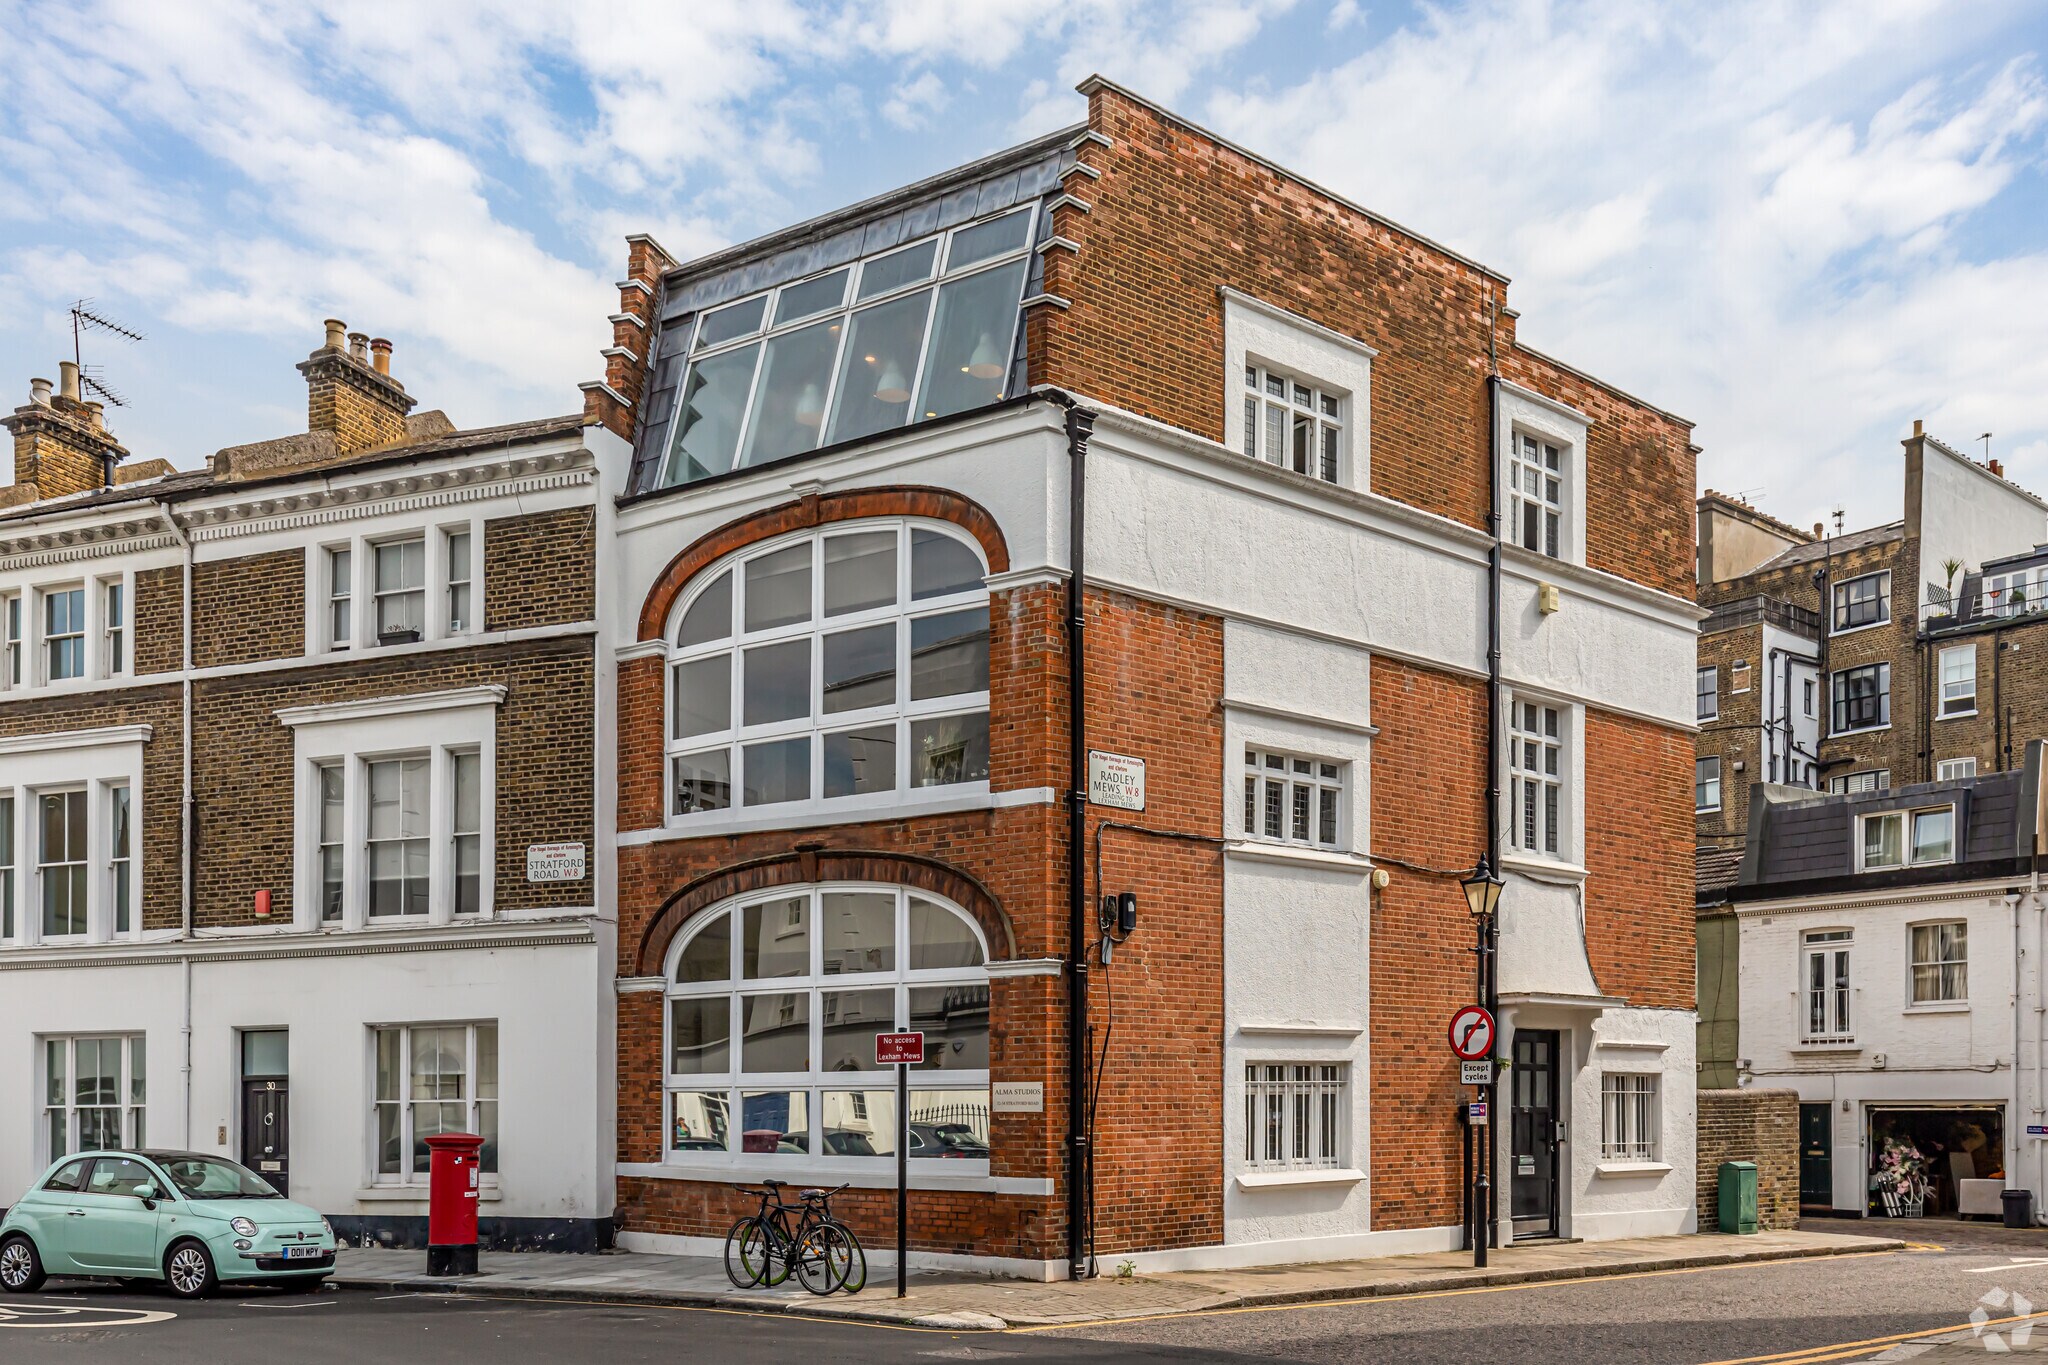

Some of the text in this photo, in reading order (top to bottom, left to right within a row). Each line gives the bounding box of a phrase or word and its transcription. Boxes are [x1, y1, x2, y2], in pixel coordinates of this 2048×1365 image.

[1100, 770, 1135, 785] RADLEY
[1125, 786, 1140, 798] W.8
[1102, 792, 1125, 802] LEADING
[1098, 798, 1120, 806] LEXHAM
[530, 858, 584, 870] STRATFORD
[564, 868, 578, 877] W.8
[1464, 1064, 1488, 1072] Except
[1465, 1073, 1488, 1081] cycles
[266, 1081, 276, 1090] 30
